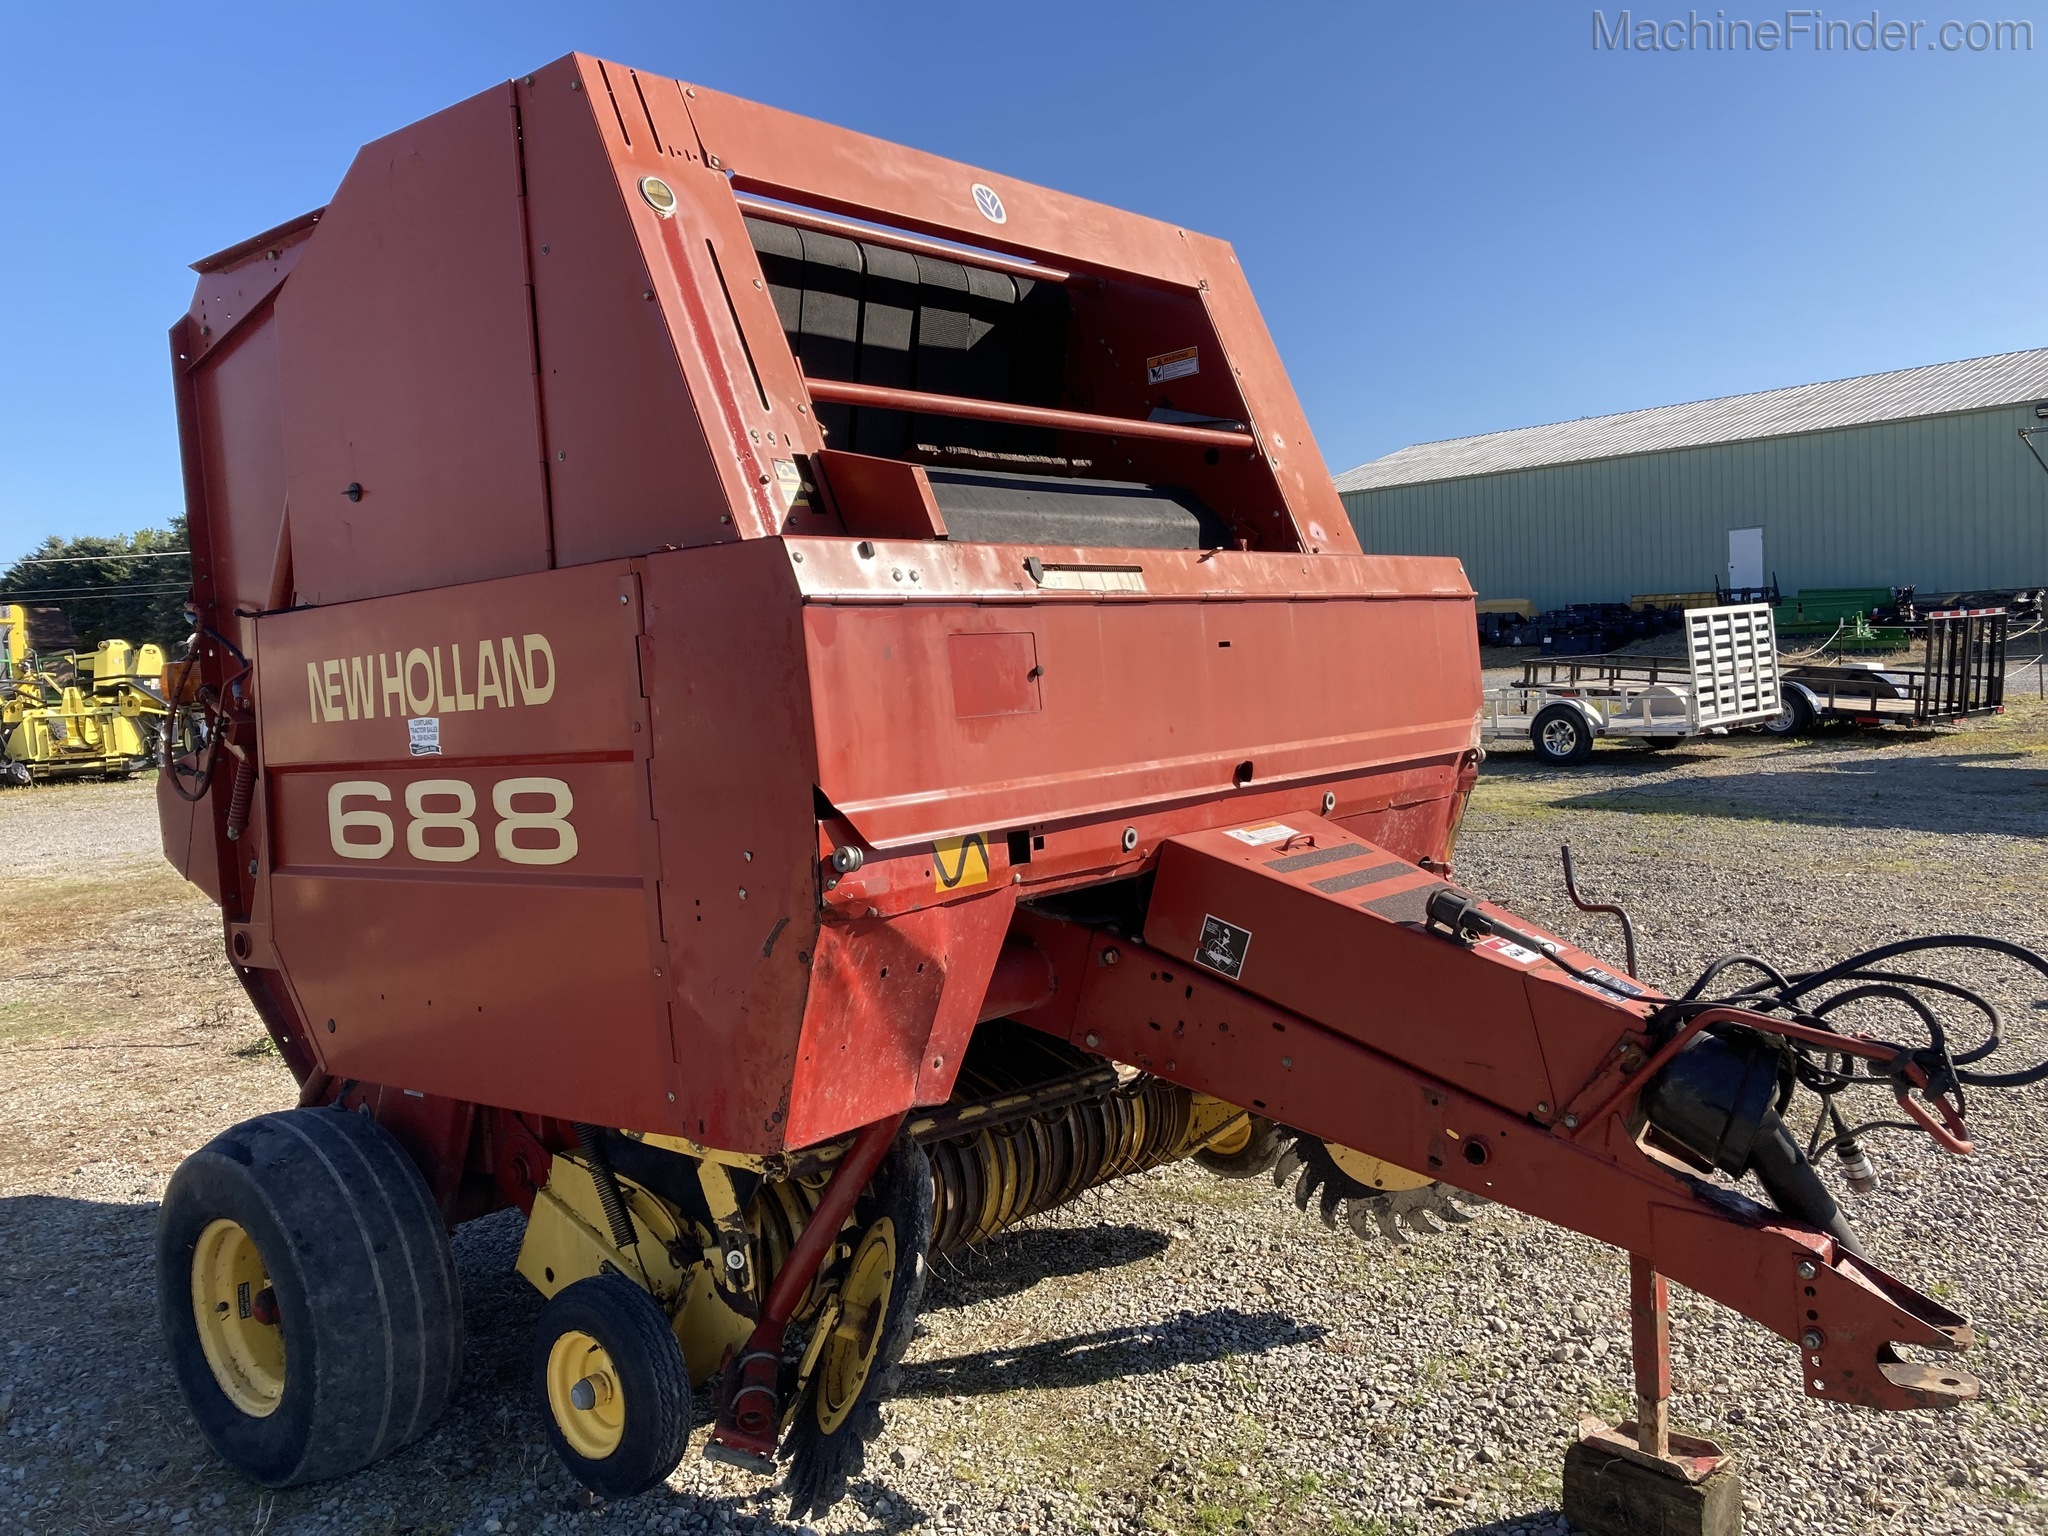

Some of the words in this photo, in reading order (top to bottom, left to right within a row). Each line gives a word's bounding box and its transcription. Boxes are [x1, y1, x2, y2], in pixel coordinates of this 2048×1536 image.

[1164, 352, 1189, 362] WARNING
[307, 655, 374, 723] NEW
[379, 633, 556, 717] HOLLAND
[327, 777, 578, 865] 688
